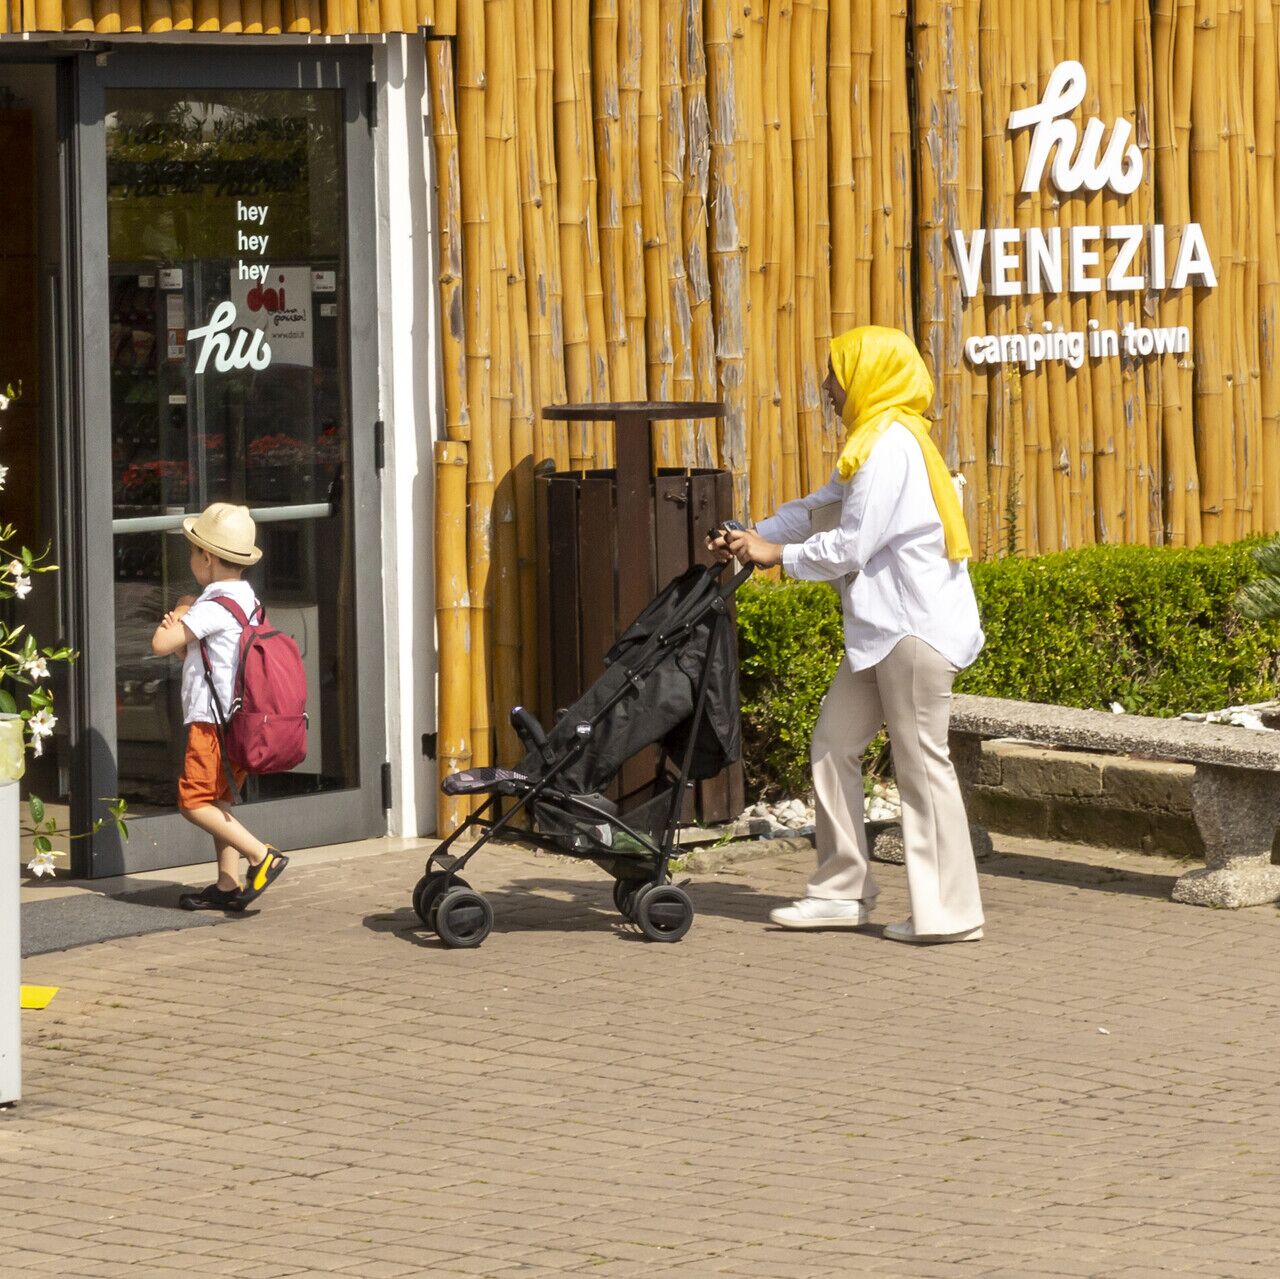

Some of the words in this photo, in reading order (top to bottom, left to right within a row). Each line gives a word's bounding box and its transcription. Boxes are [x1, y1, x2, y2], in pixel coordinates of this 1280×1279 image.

[1008, 60, 1144, 195] hu
[237, 200, 269, 225] hey
[238, 229, 269, 255] hey
[952, 222, 1218, 298] VENEZIA
[238, 260, 270, 284] hey
[187, 301, 272, 374] hu
[965, 321, 1086, 370] camping
[1089, 319, 1119, 357] in
[1124, 323, 1190, 357] town
